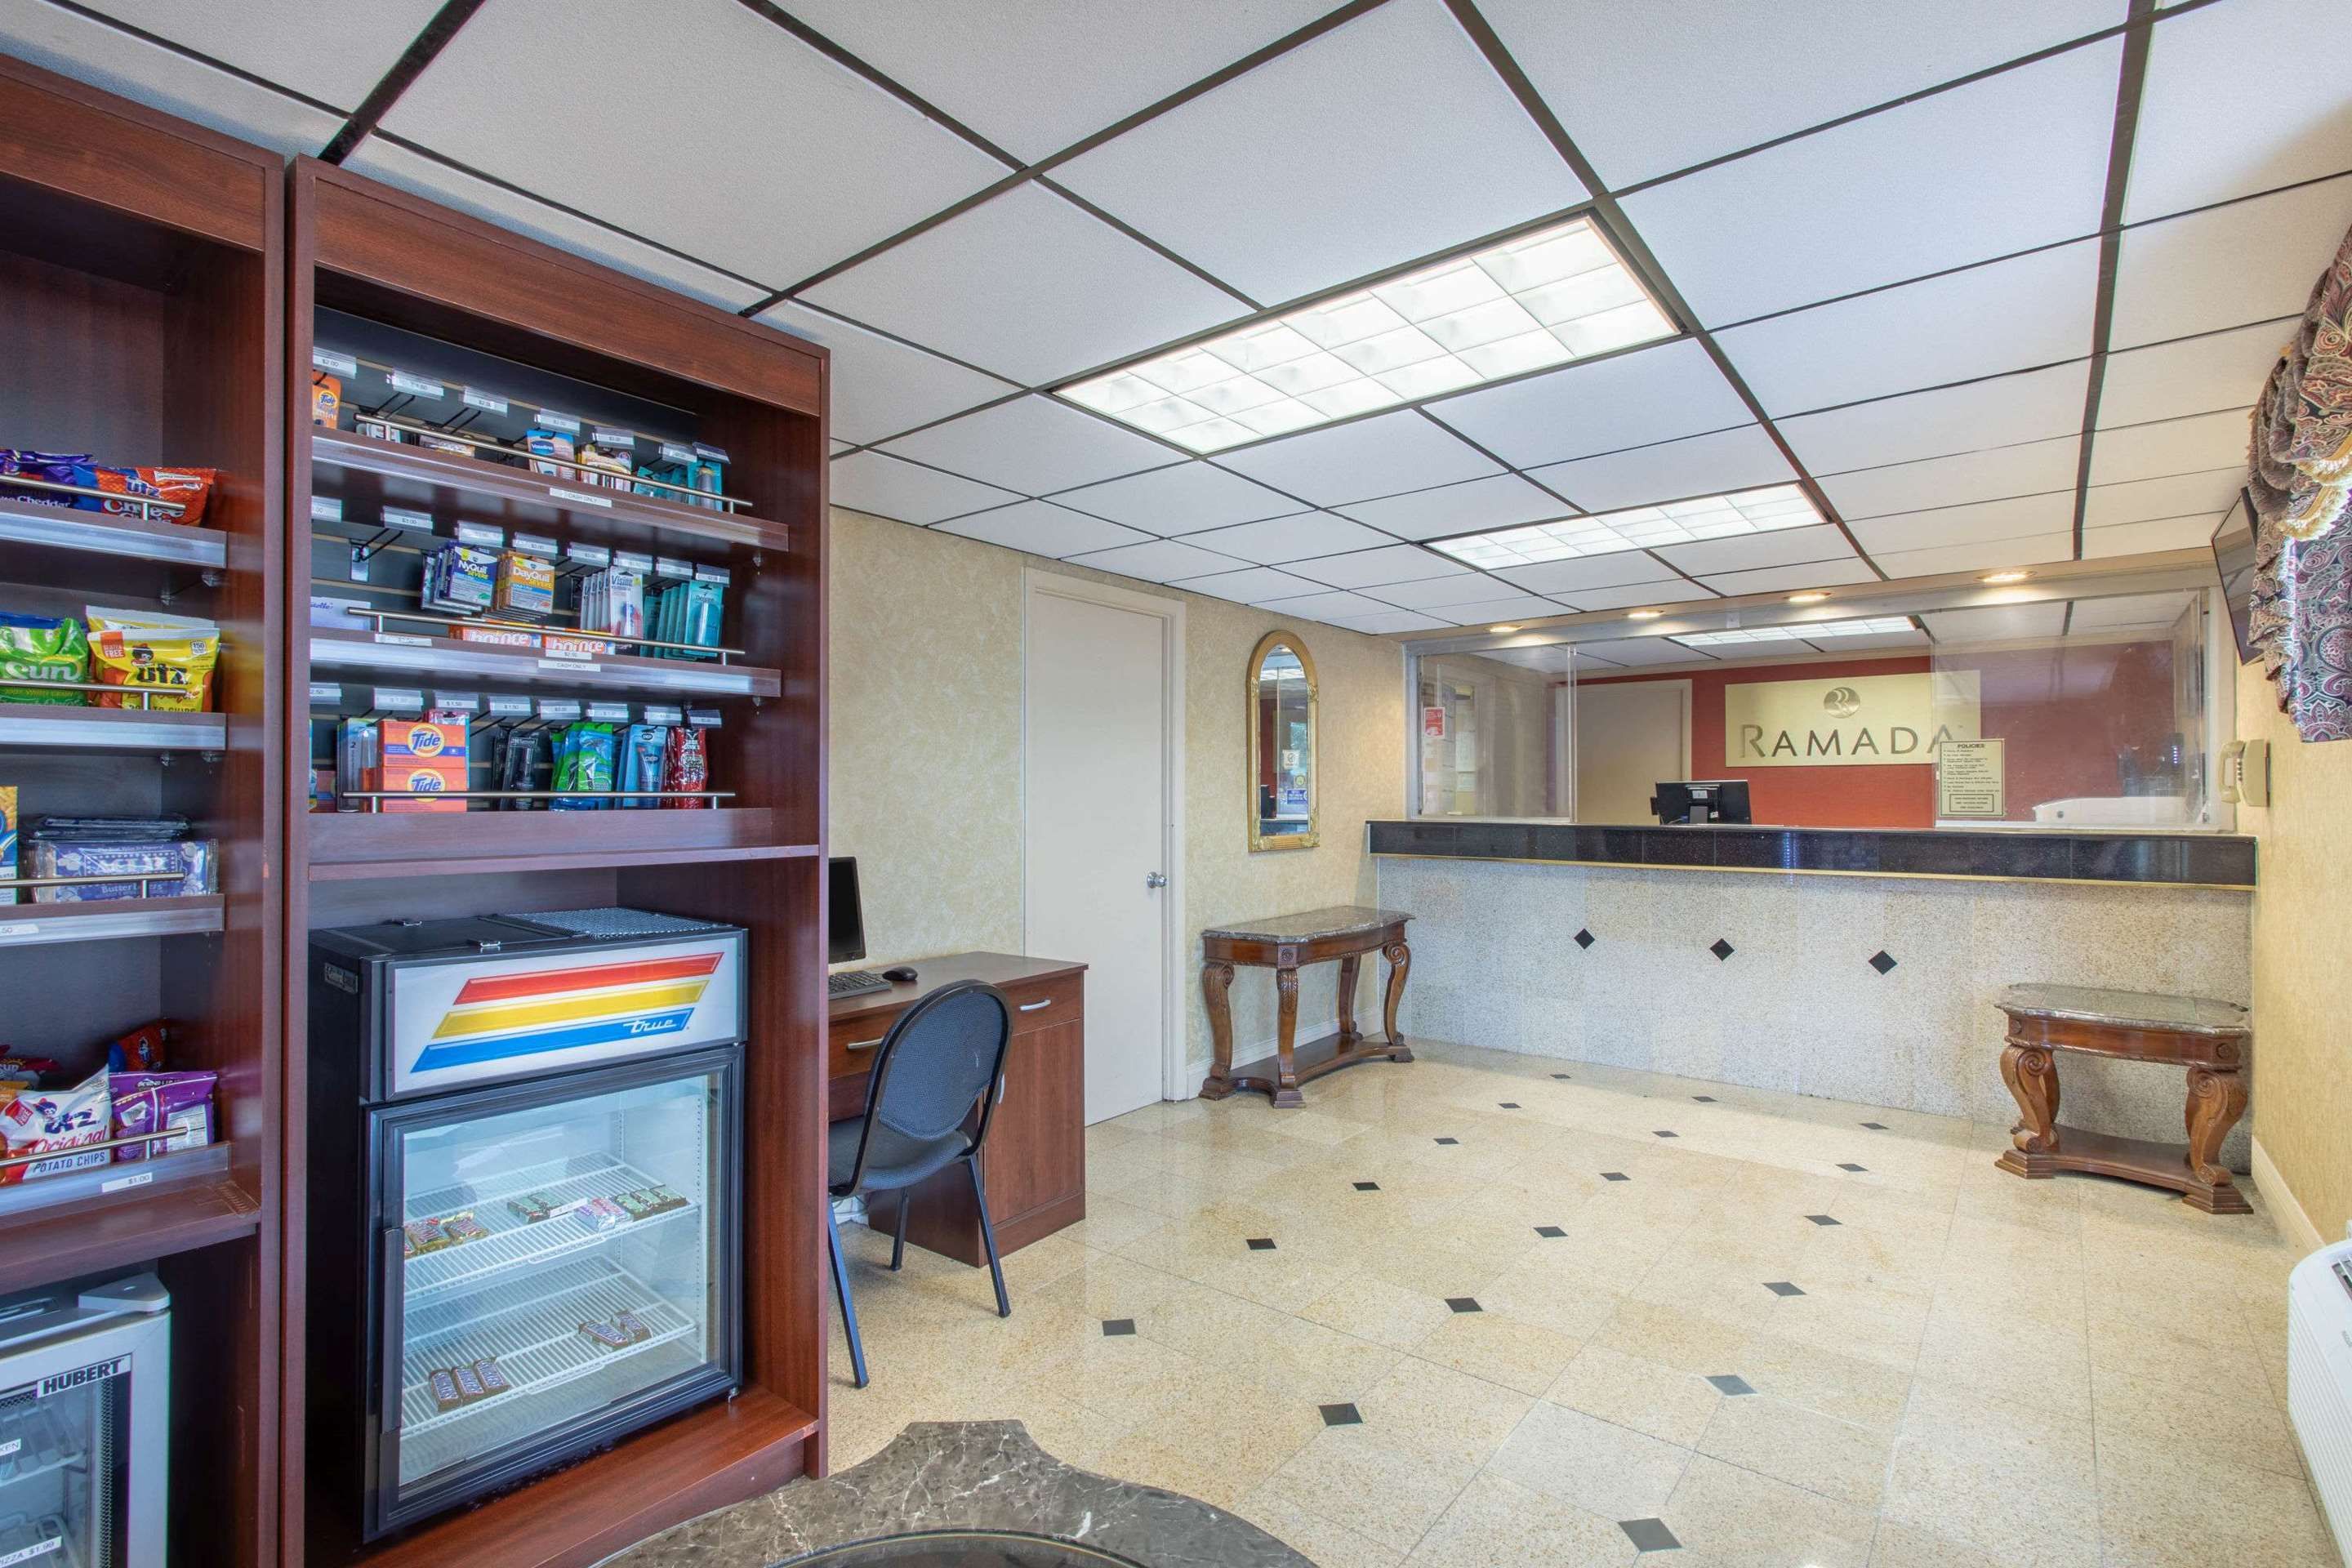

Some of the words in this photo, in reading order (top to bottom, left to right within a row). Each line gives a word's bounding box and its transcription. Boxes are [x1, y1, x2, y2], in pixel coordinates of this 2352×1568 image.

[458, 559, 488, 576] NyQuil
[513, 566, 550, 582] DayQuil
[105, 649, 123, 658] FREE
[411, 732, 440, 751] Tide
[1740, 724, 1953, 759] RAMADA
[412, 777, 442, 790] Tide
[33, 1125, 107, 1153] Original
[33, 1158, 73, 1173] POTATO
[77, 1152, 106, 1166] CHIPS
[128, 1174, 149, 1184] $1.00
[43, 1359, 121, 1395] HUBERT
